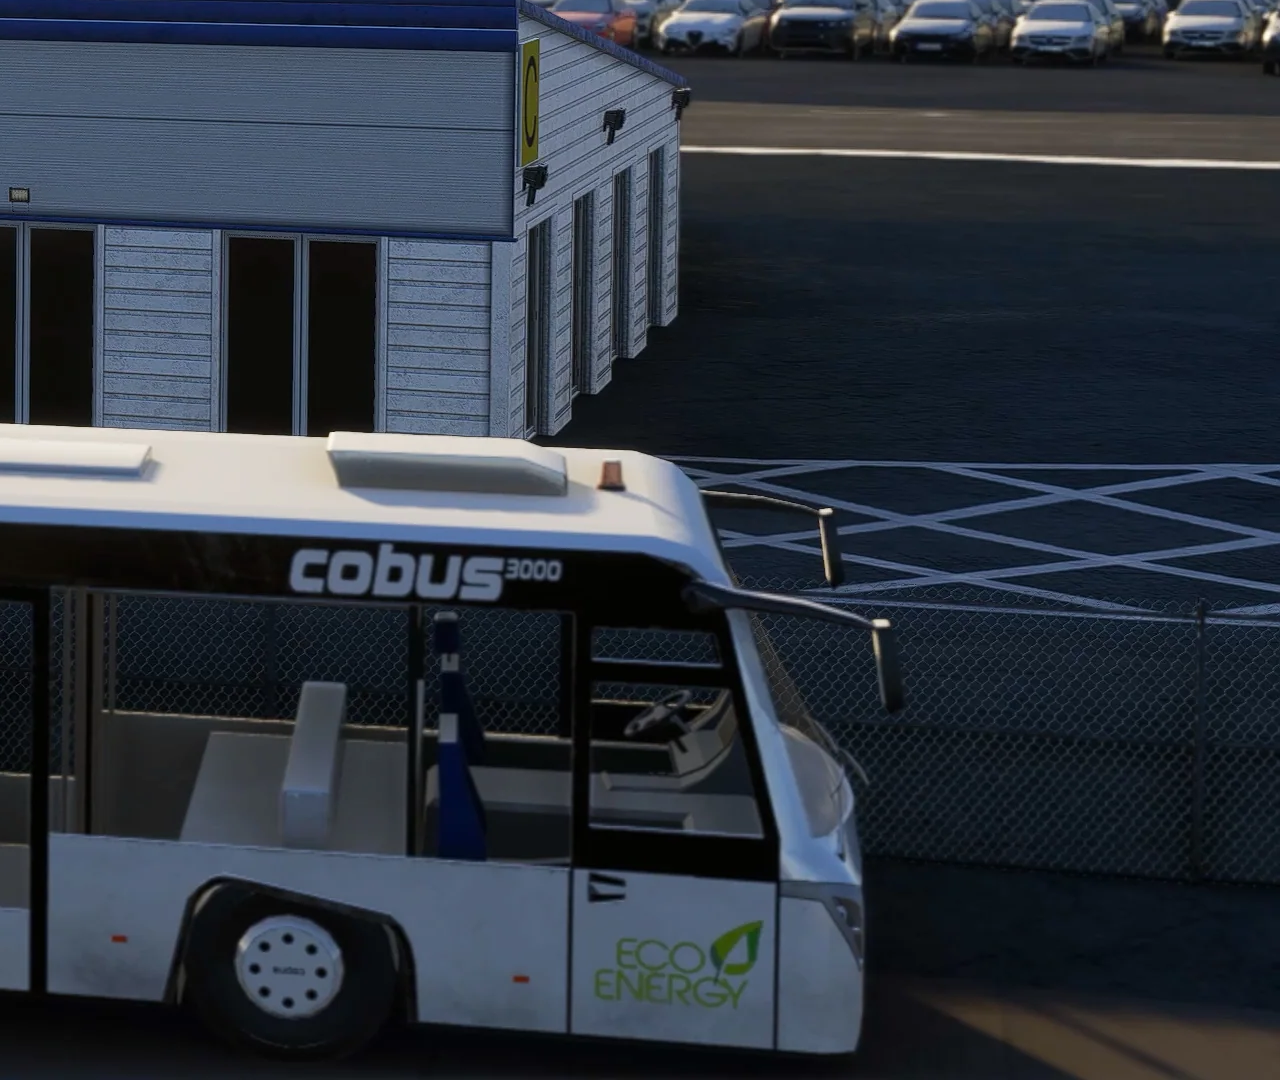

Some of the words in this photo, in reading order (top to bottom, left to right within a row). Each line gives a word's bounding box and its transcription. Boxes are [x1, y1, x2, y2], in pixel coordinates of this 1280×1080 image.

[289, 543, 504, 601] cobus
[505, 558, 562, 581] 3000
[616, 937, 706, 974] ECO
[593, 968, 748, 1010] ENERGY
